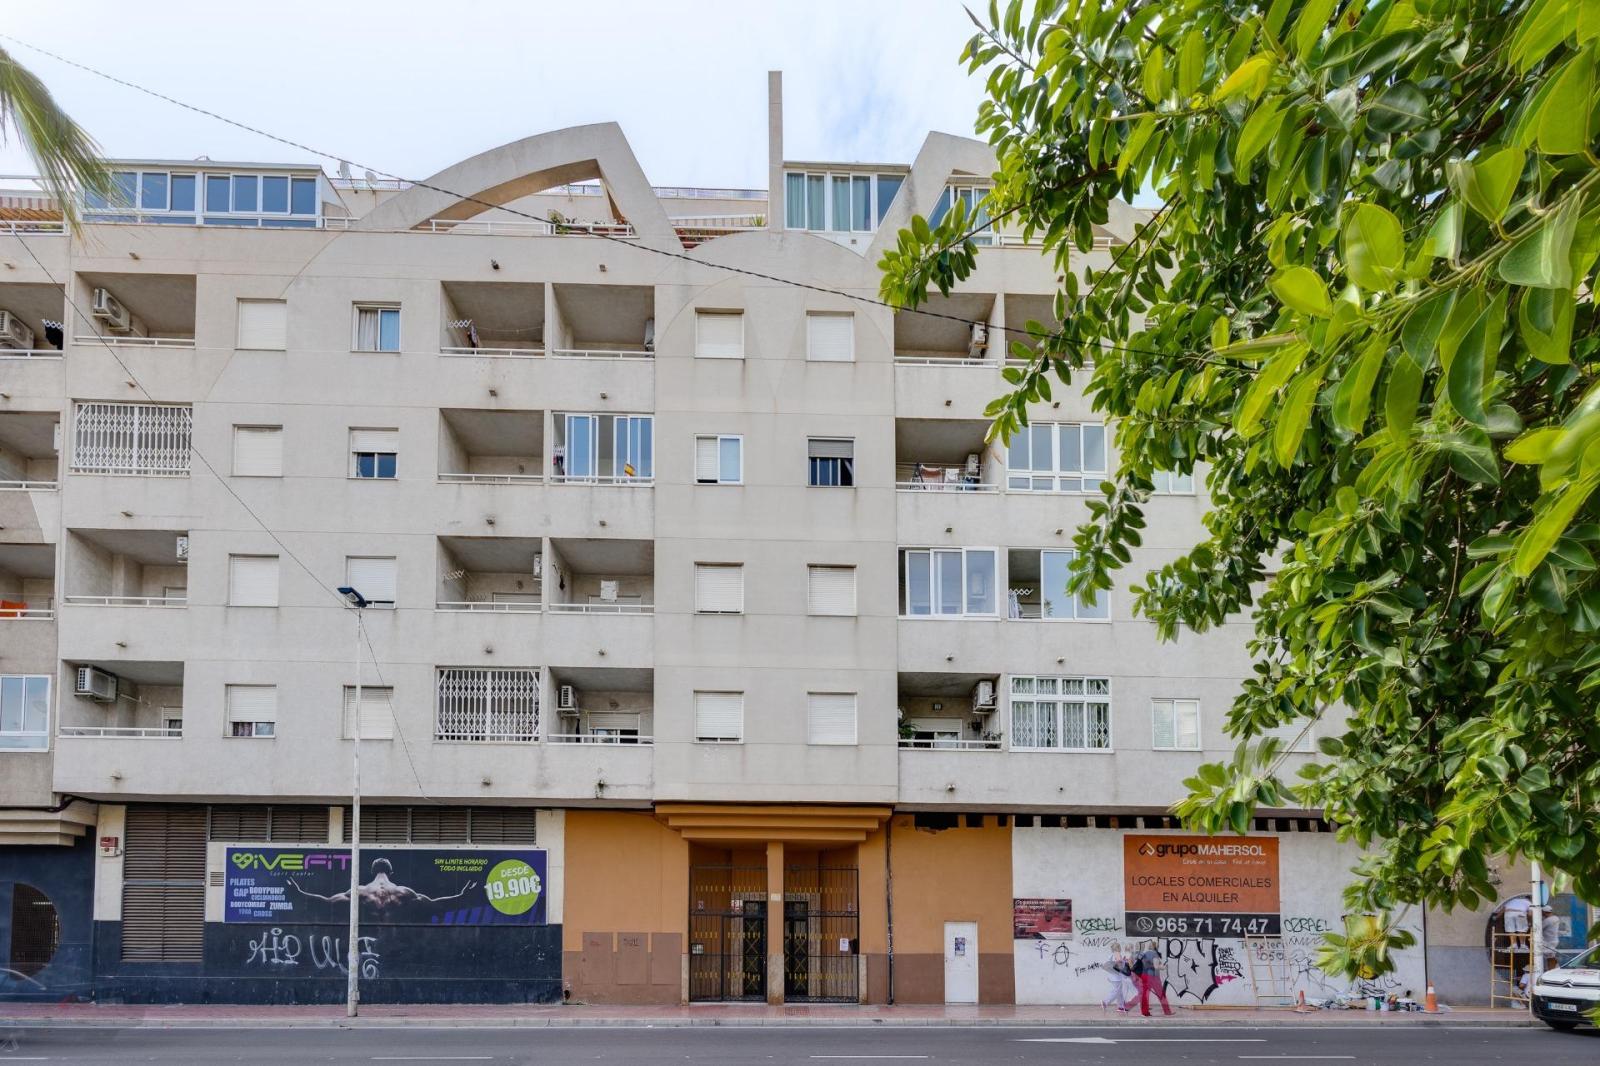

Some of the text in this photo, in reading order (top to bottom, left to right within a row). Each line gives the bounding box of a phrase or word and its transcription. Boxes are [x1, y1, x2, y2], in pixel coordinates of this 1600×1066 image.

[501, 866, 529, 878] DESDE
[230, 878, 255, 886] PILATES
[484, 874, 541, 901] 19.90€
[1132, 876, 1272, 888] LOCALES COMERCIALES
[234, 886, 284, 897] GAP BODYPUMP
[1163, 892, 1239, 903] EN ALQUILER
[269, 902, 293, 910] ZUMBA
[1156, 917, 1269, 934] 965 71 74 47
